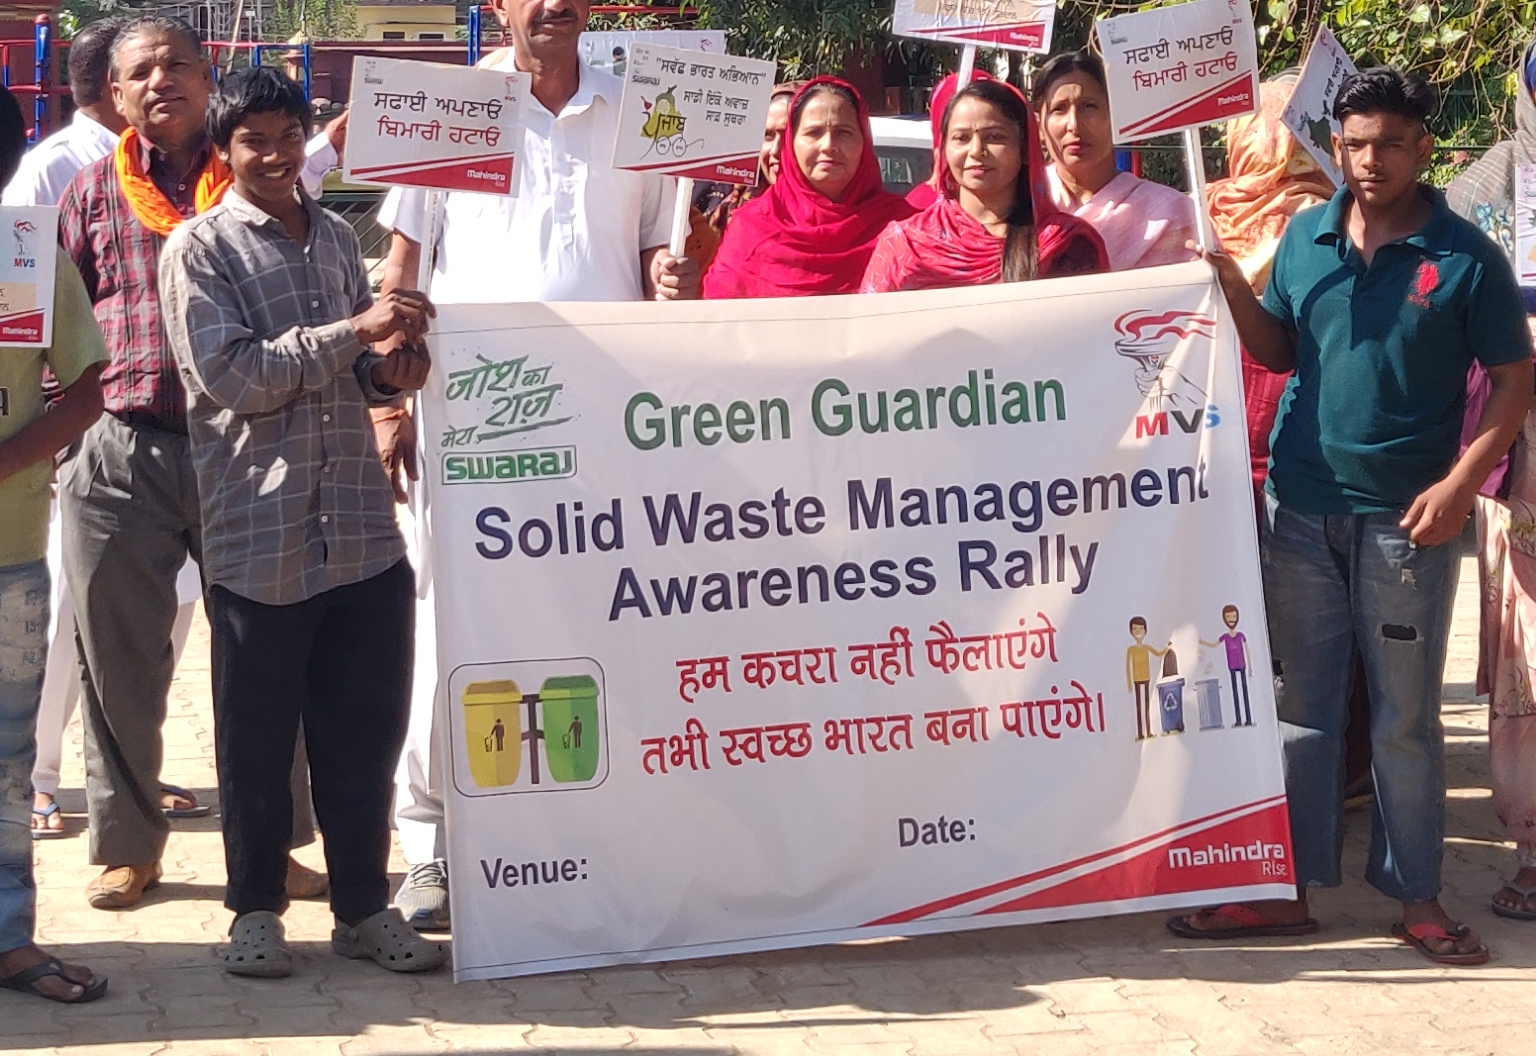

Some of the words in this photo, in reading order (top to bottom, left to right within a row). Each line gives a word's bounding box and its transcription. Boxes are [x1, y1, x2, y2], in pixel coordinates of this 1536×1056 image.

[1176, 25, 1234, 54] ਅਪਣਾਓ
[689, 63, 716, 79] ਭਾਰਤ
[1132, 61, 1188, 91] ਬਿਮਾਰੀ
[1194, 51, 1238, 78] ਹਟਾਓ
[374, 90, 428, 112] ਸਫਾਈ
[434, 97, 503, 120] ਅਪਣਾਓ
[1217, 92, 1249, 106] Mahindra
[377, 115, 442, 141] ਬਿਮਾਰੀ
[449, 126, 501, 147] ਹਟਾਓ
[467, 169, 506, 182] Mahindra
[716, 165, 755, 179] Mahindra
[14, 258, 36, 268] MVS
[446, 354, 529, 401] जोश
[522, 365, 553, 386] का
[624, 391, 791, 451] Green
[811, 368, 1066, 436] Guardian
[1135, 404, 1221, 439] MVS
[441, 424, 479, 447] मेरा
[475, 498, 624, 560] Solid
[642, 491, 826, 547] Waste
[847, 454, 1209, 533] Management
[609, 556, 937, 621] Awareness
[958, 533, 1099, 595] Rally
[676, 656, 733, 703] हम
[741, 647, 838, 689] कचरा
[848, 626, 915, 685] नहीं
[925, 611, 1058, 674] फैलाएंगे
[641, 718, 711, 774] तभी
[719, 722, 812, 766] स्वच्छ
[824, 714, 914, 755] भारत
[924, 706, 989, 745] बना
[898, 815, 976, 847] Date:
[1168, 839, 1285, 868] Mahindra
[480, 856, 589, 889] Venue:
